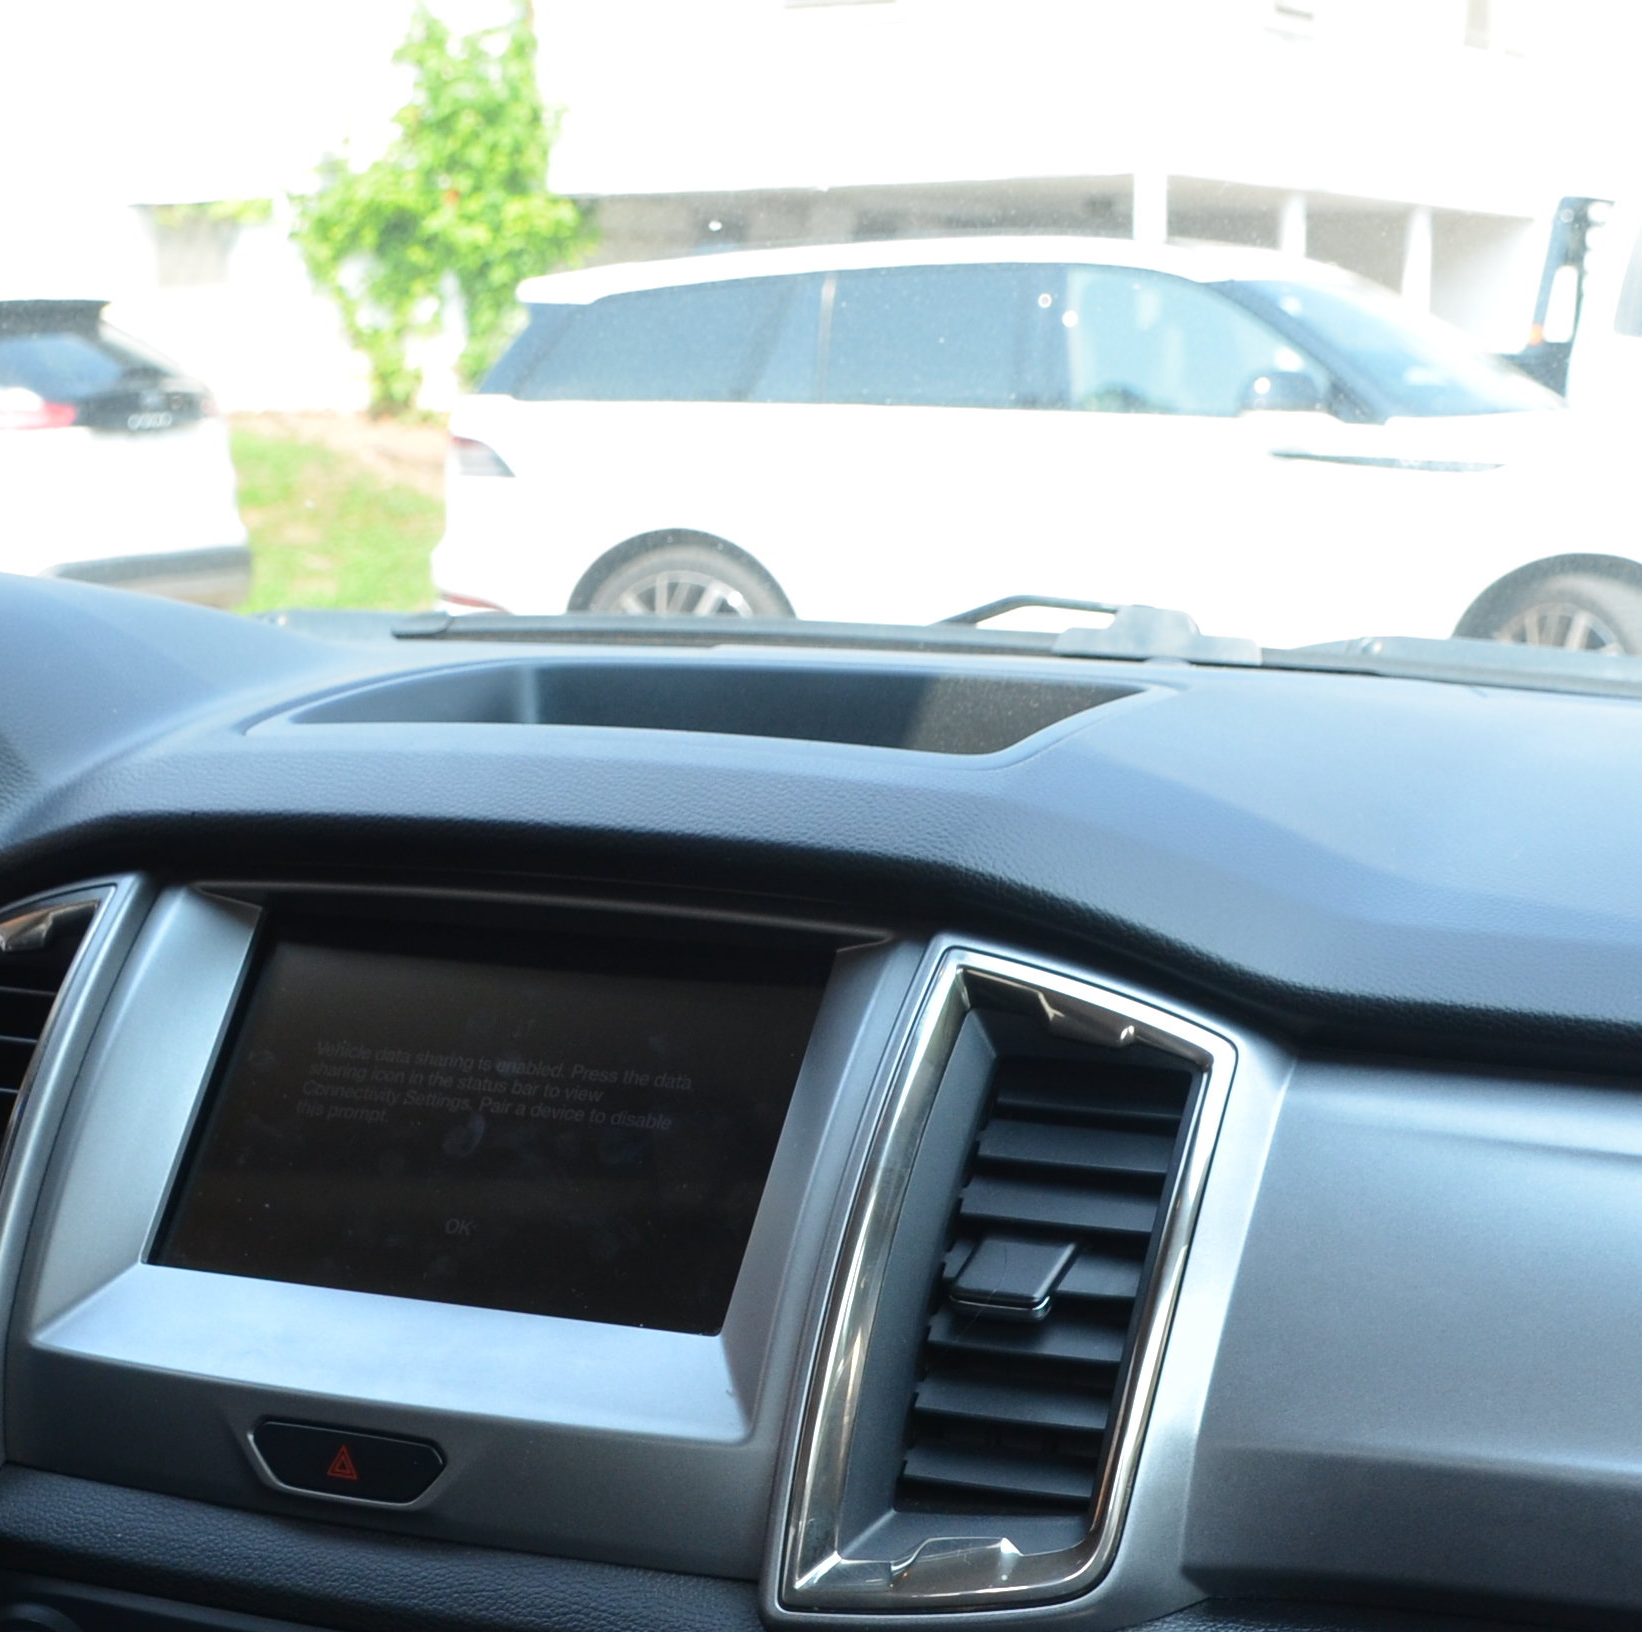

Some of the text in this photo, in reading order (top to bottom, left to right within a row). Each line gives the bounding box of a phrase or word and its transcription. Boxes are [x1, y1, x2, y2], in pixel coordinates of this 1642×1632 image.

[309, 1061, 603, 1103] sharing icon in the status bar to view
[317, 1040, 692, 1091] Vehicle data sharing is enabled. Press the data
[296, 1099, 389, 1124] this prompt.
[303, 1080, 399, 1106] Connectivity
[478, 1096, 511, 1113] Pair
[515, 1103, 525, 1116] a
[530, 1103, 584, 1122] device
[589, 1107, 605, 1124] to
[610, 1110, 671, 1131] disable
[445, 1217, 474, 1237] OK
